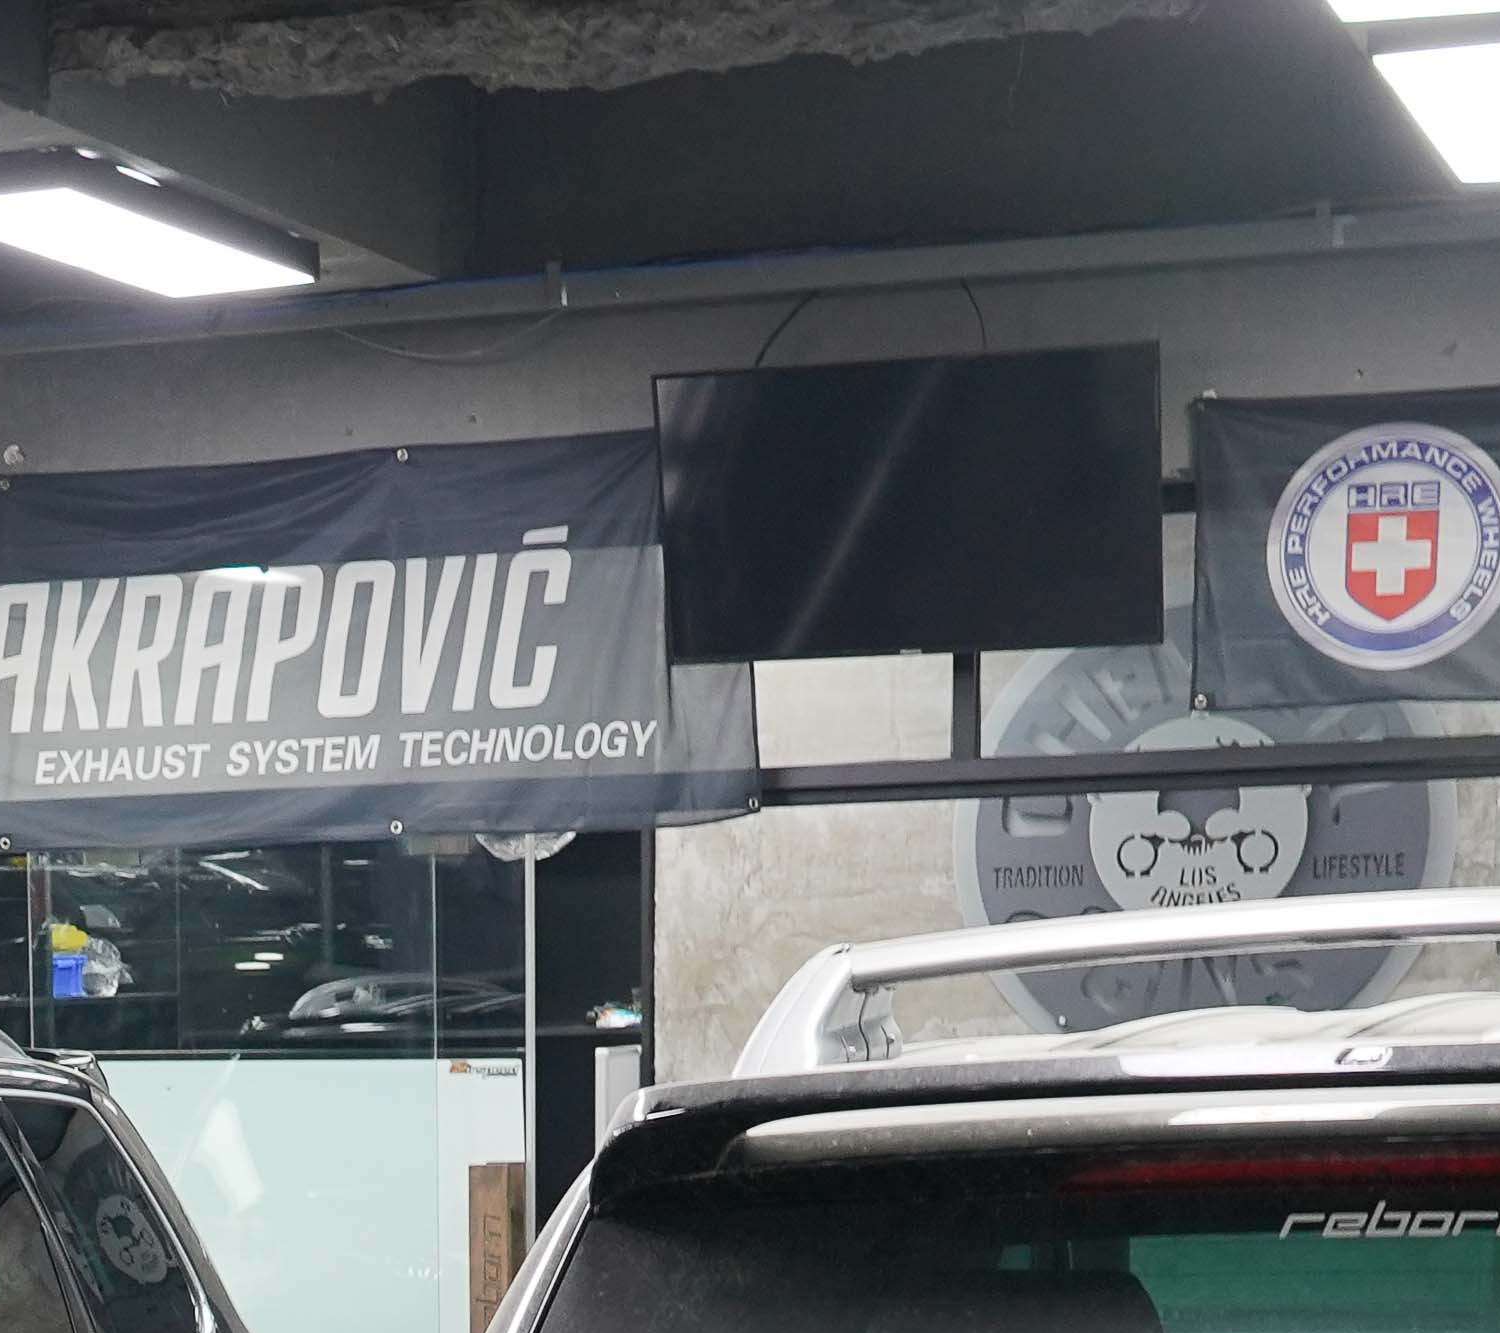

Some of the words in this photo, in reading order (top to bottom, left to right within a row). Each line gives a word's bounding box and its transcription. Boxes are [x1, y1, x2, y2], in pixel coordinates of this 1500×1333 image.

[1346, 481, 1441, 509] HRE
[1287, 440, 1484, 556] PERFORMANCE
[1450, 495, 1500, 622] WHEELS
[33, 741, 206, 787] EXHAUST
[226, 734, 380, 776] SYSTEM
[400, 719, 658, 767] TECHNOLOGY
[993, 864, 1085, 889] TRADITION
[1311, 852, 1406, 880] LIFESTYLE
